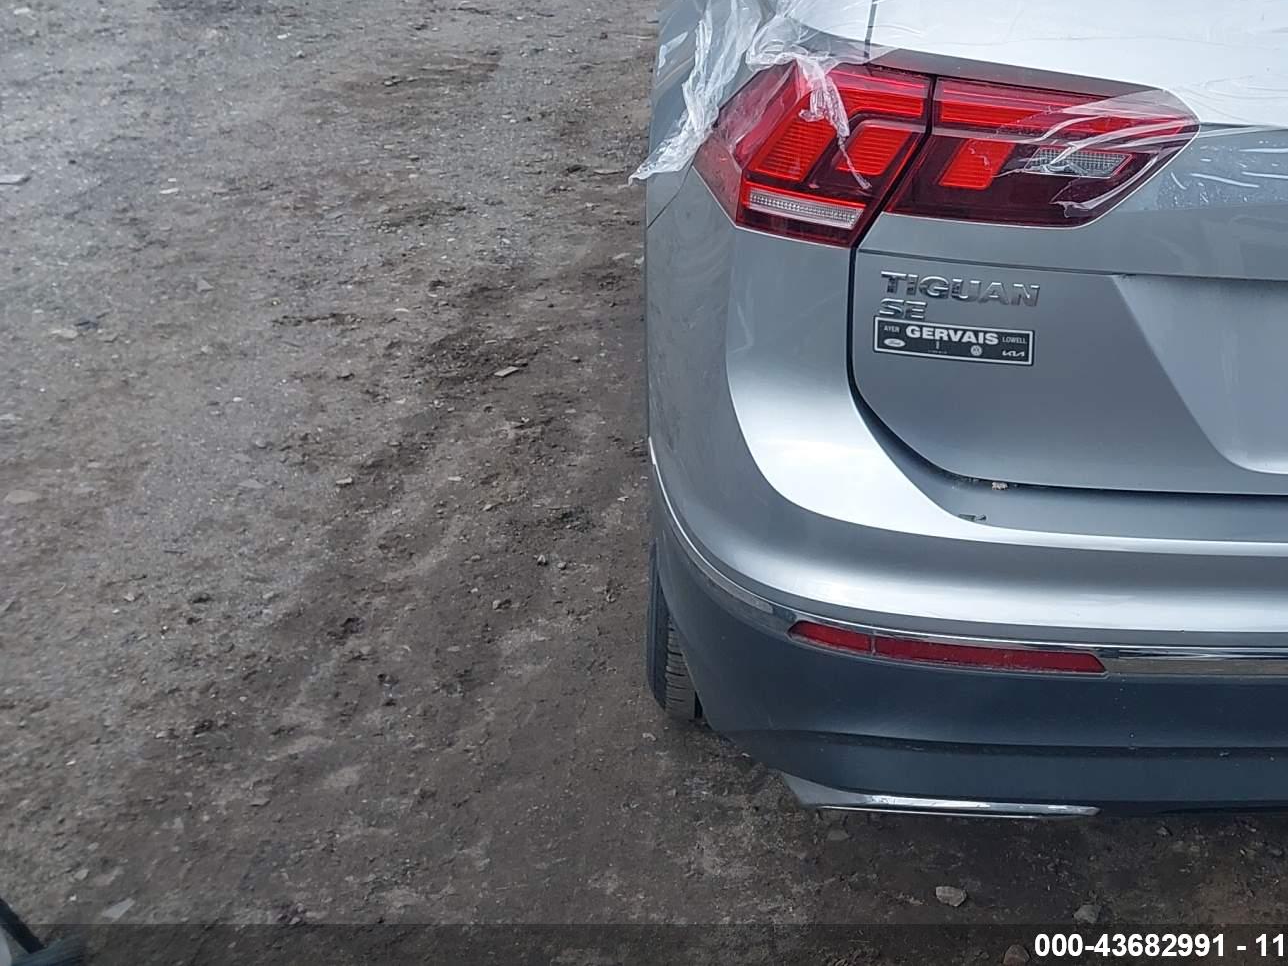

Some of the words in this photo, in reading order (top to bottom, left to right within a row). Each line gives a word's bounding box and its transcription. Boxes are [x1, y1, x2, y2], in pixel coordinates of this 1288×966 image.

[880, 270, 1041, 307] TIGUAN
[878, 297, 928, 319] SE
[905, 325, 999, 345] GERVAIS
[1001, 336, 1027, 344] LOWELL
